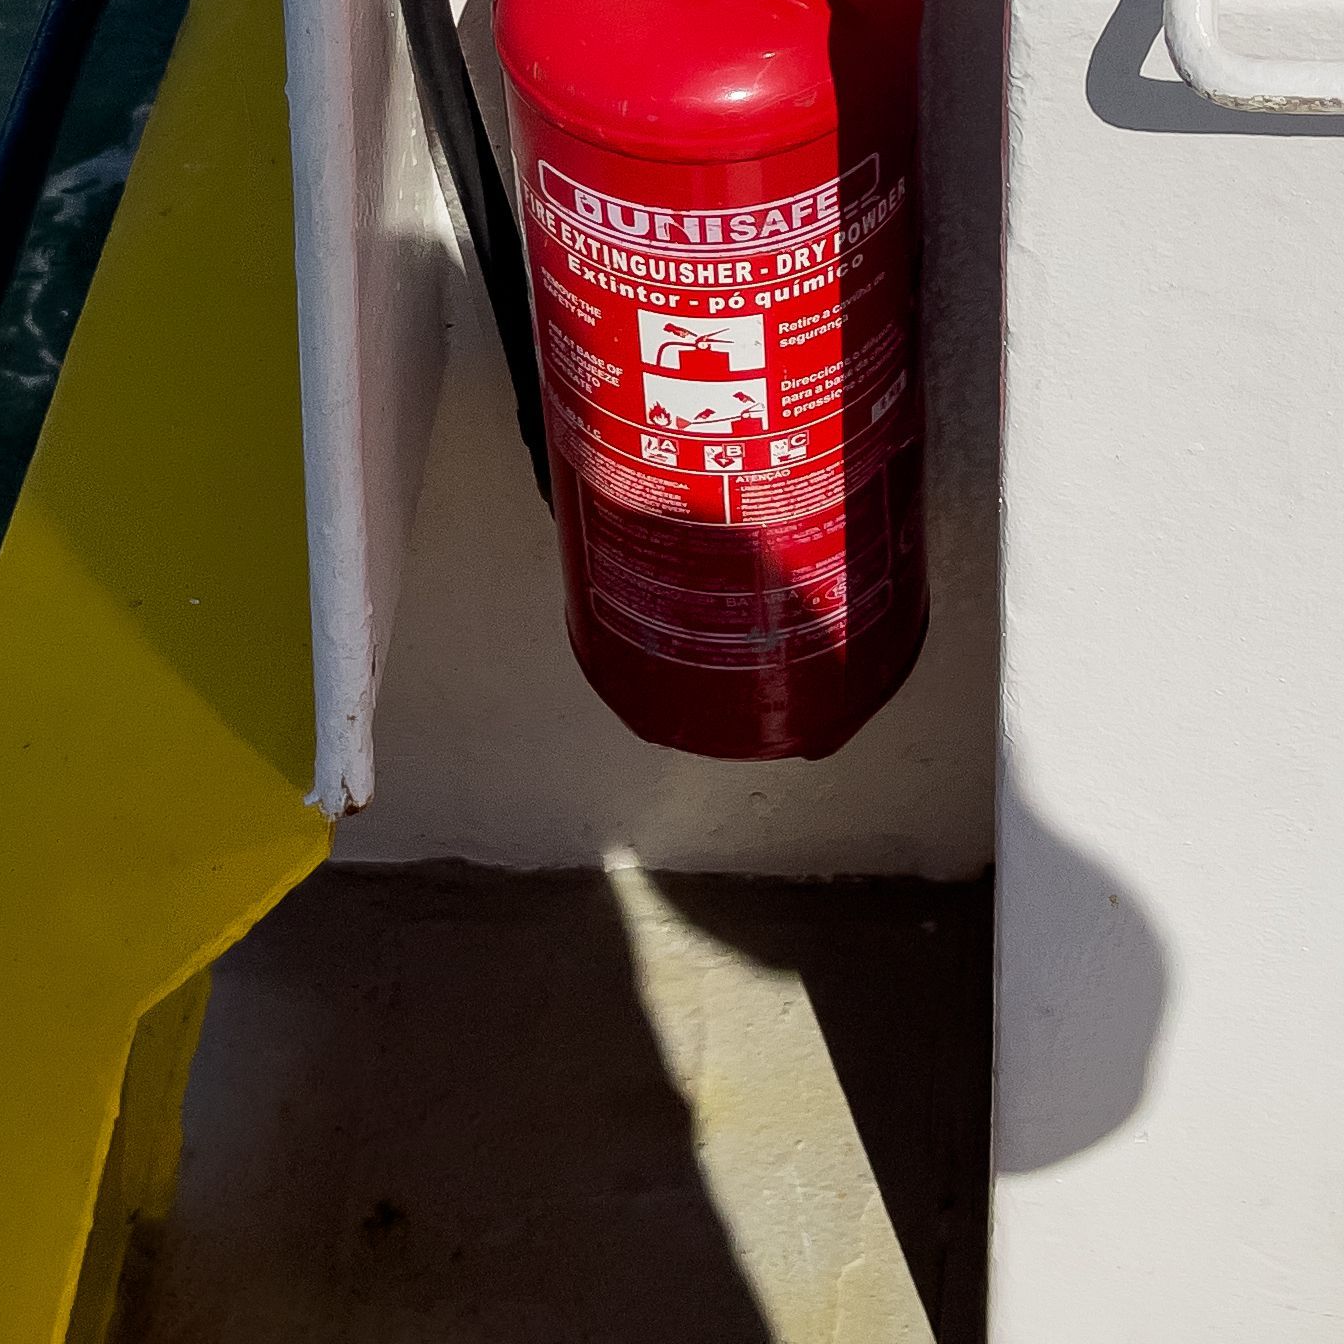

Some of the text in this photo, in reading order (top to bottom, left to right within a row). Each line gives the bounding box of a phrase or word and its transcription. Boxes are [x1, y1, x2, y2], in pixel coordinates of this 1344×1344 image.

[523, 183, 557, 234] FIRE
[560, 221, 754, 285] EXTINGUISHER
[776, 238, 827, 276] DRY
[833, 175, 907, 255] POWDER
[567, 253, 681, 308] Extintor
[708, 291, 746, 314] pó
[755, 254, 864, 309] químico
[576, 308, 597, 327] PIN
[778, 313, 821, 335] Retire
[779, 314, 849, 348] segurança
[576, 344, 606, 369] BASE
[606, 362, 624, 377] OF
[781, 387, 813, 407] para
[659, 439, 677, 453] A
[789, 433, 807, 446] C
[725, 445, 743, 456] B
